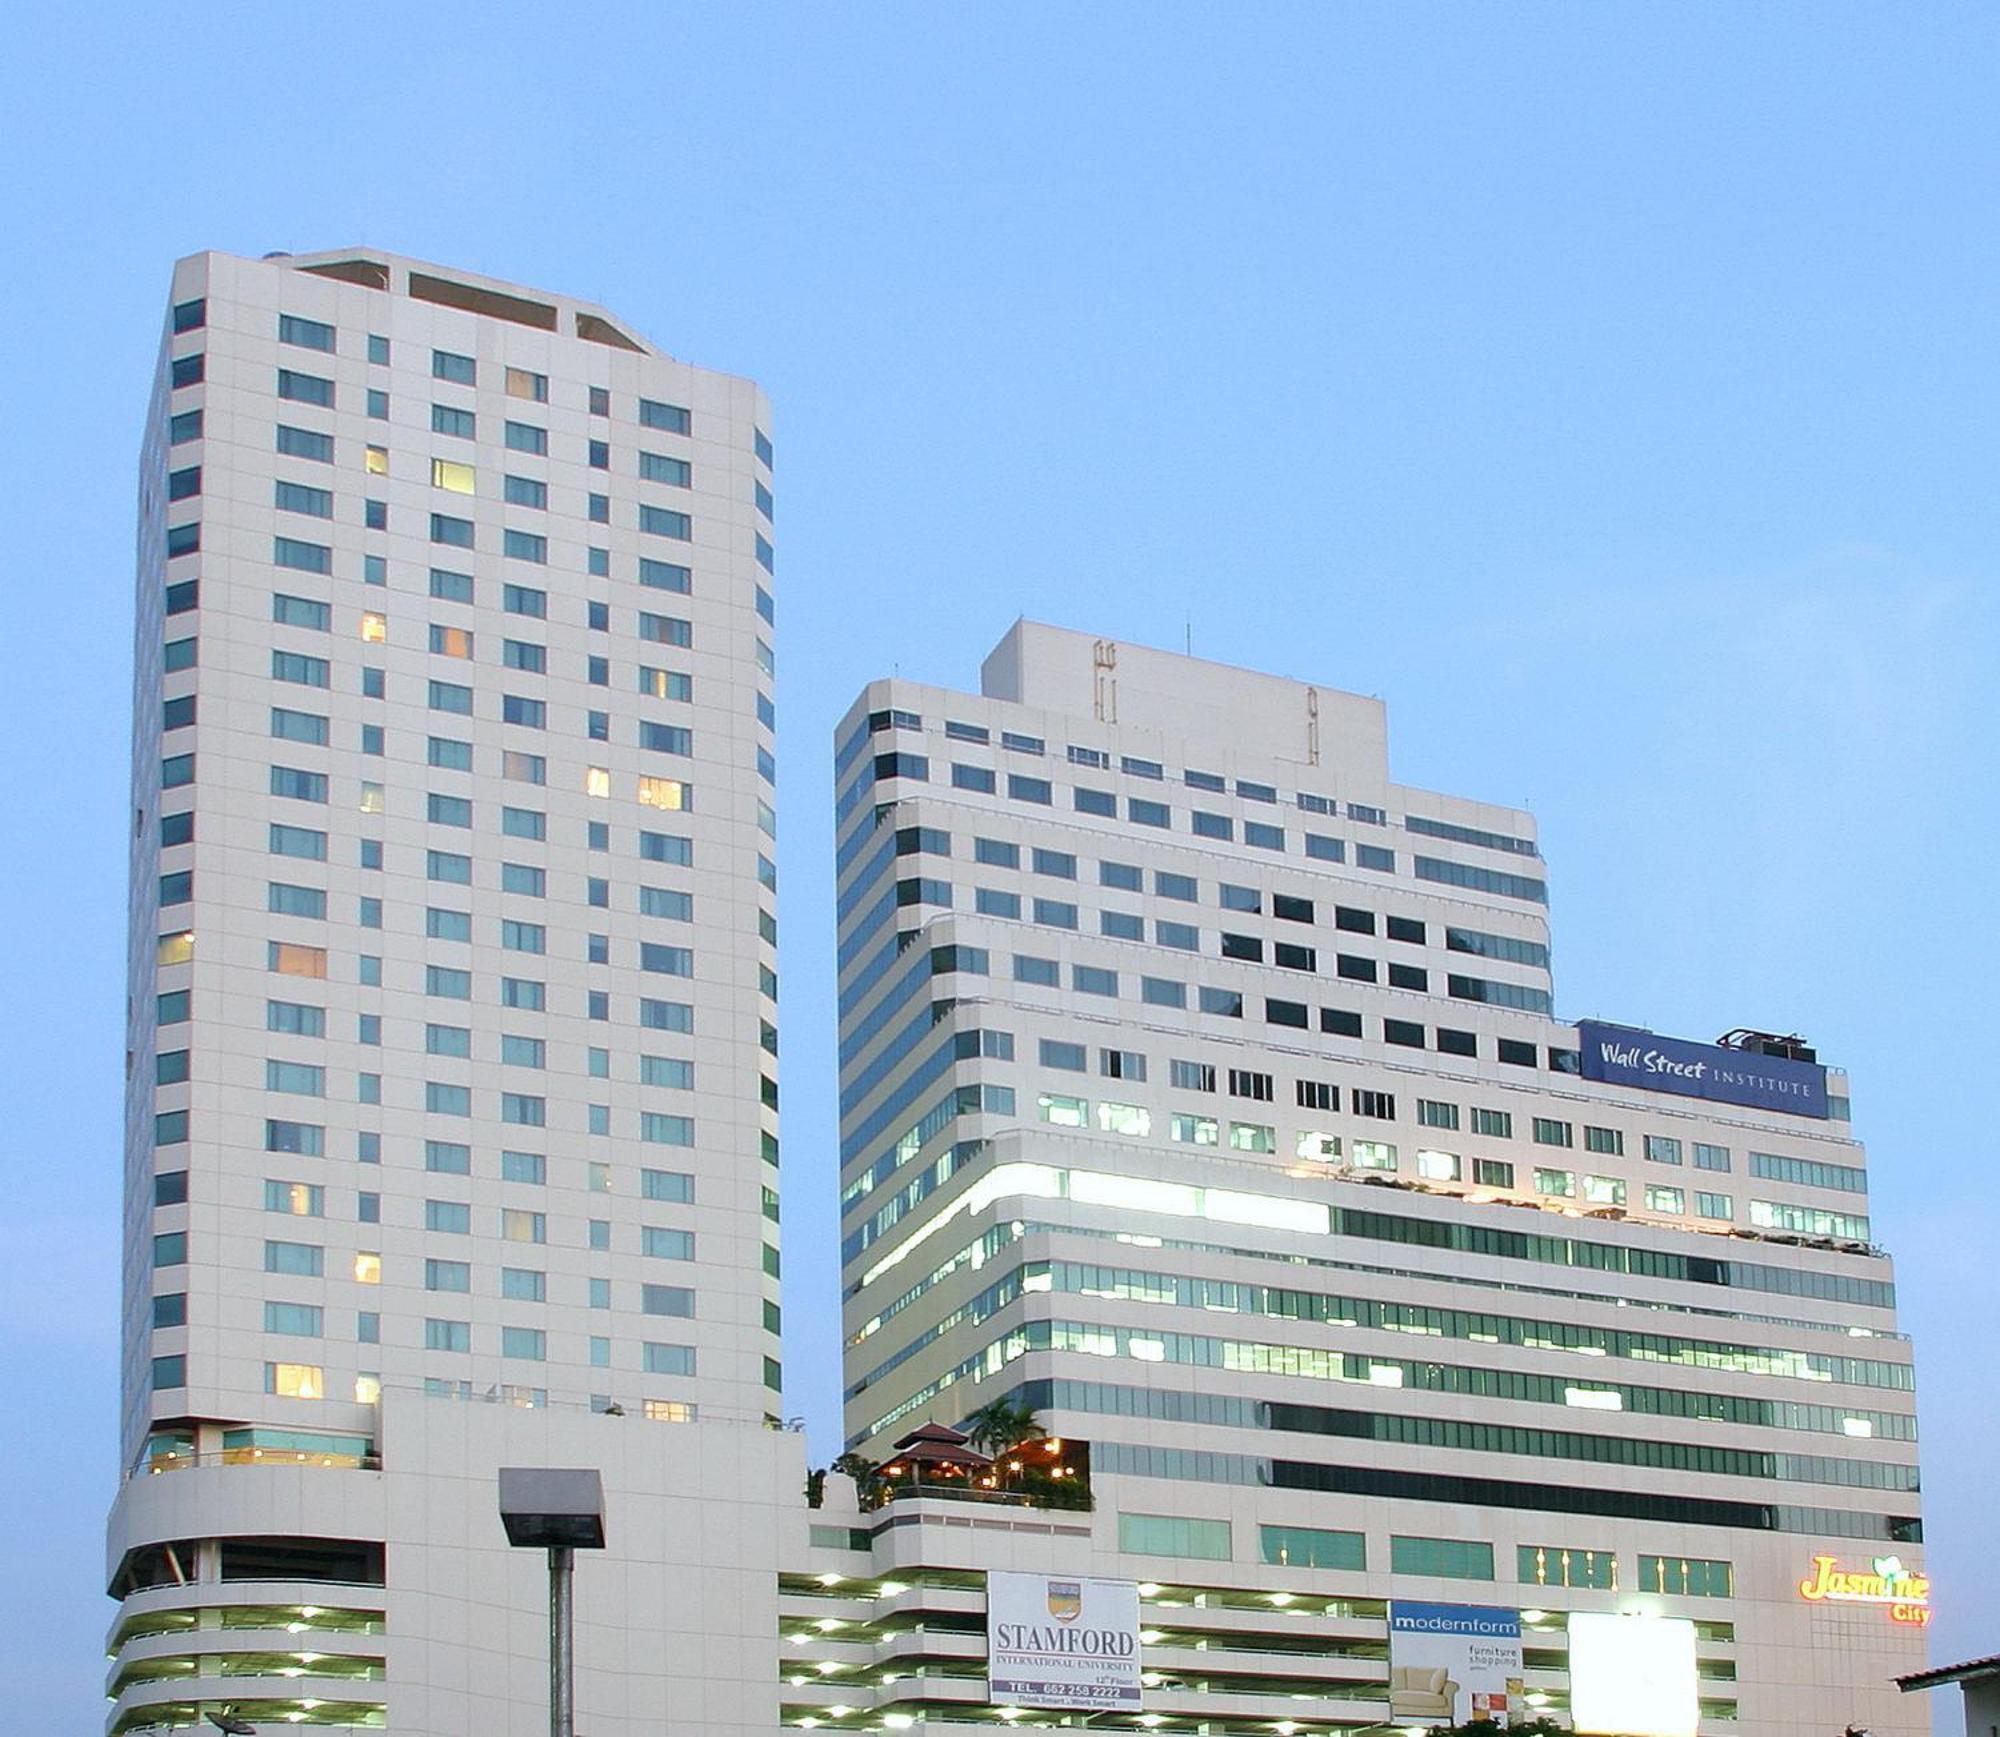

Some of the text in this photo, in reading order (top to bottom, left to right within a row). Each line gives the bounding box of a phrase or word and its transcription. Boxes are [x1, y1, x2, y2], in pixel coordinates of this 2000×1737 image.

[1600, 1042, 1811, 1098] Wall Street INSTITUTE
[1800, 1555, 1930, 1601] Jasmine
[1892, 1604, 1931, 1627] City
[1395, 1616, 1517, 1634] modernform
[998, 1623, 1134, 1657] STAMFORD
[1470, 1645, 1516, 1656] furniture
[996, 1656, 1133, 1672] INTERNATIONAL UNIVERSITY
[1470, 1656, 1516, 1668] shopping
[1009, 1682, 1036, 1693] TEL.
[1092, 1687, 1121, 1698] 2222
